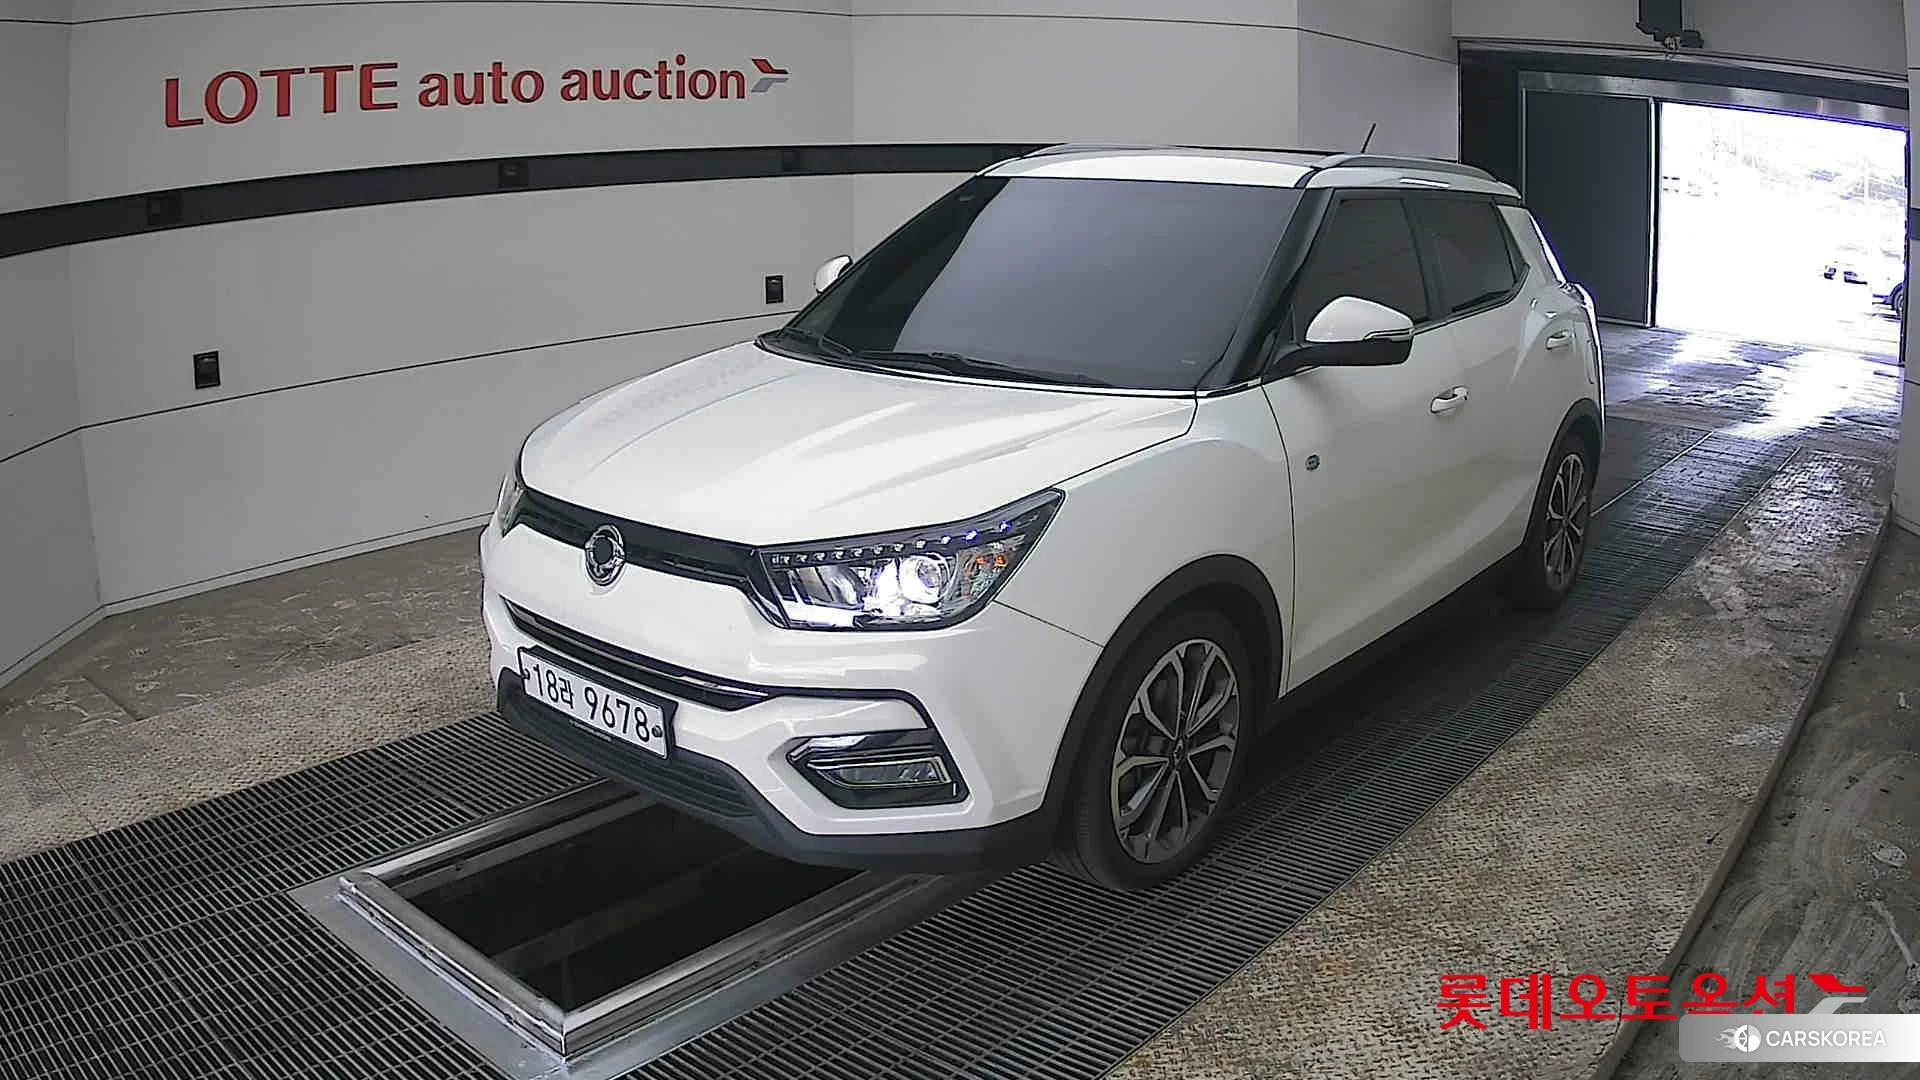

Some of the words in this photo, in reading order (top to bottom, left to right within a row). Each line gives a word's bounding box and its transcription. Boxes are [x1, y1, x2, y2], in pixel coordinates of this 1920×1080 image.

[165, 62, 398, 128] LOTTE
[418, 62, 545, 107] auto
[560, 54, 746, 101] auction
[533, 664, 574, 709] 18라
[584, 687, 649, 742] 9678
